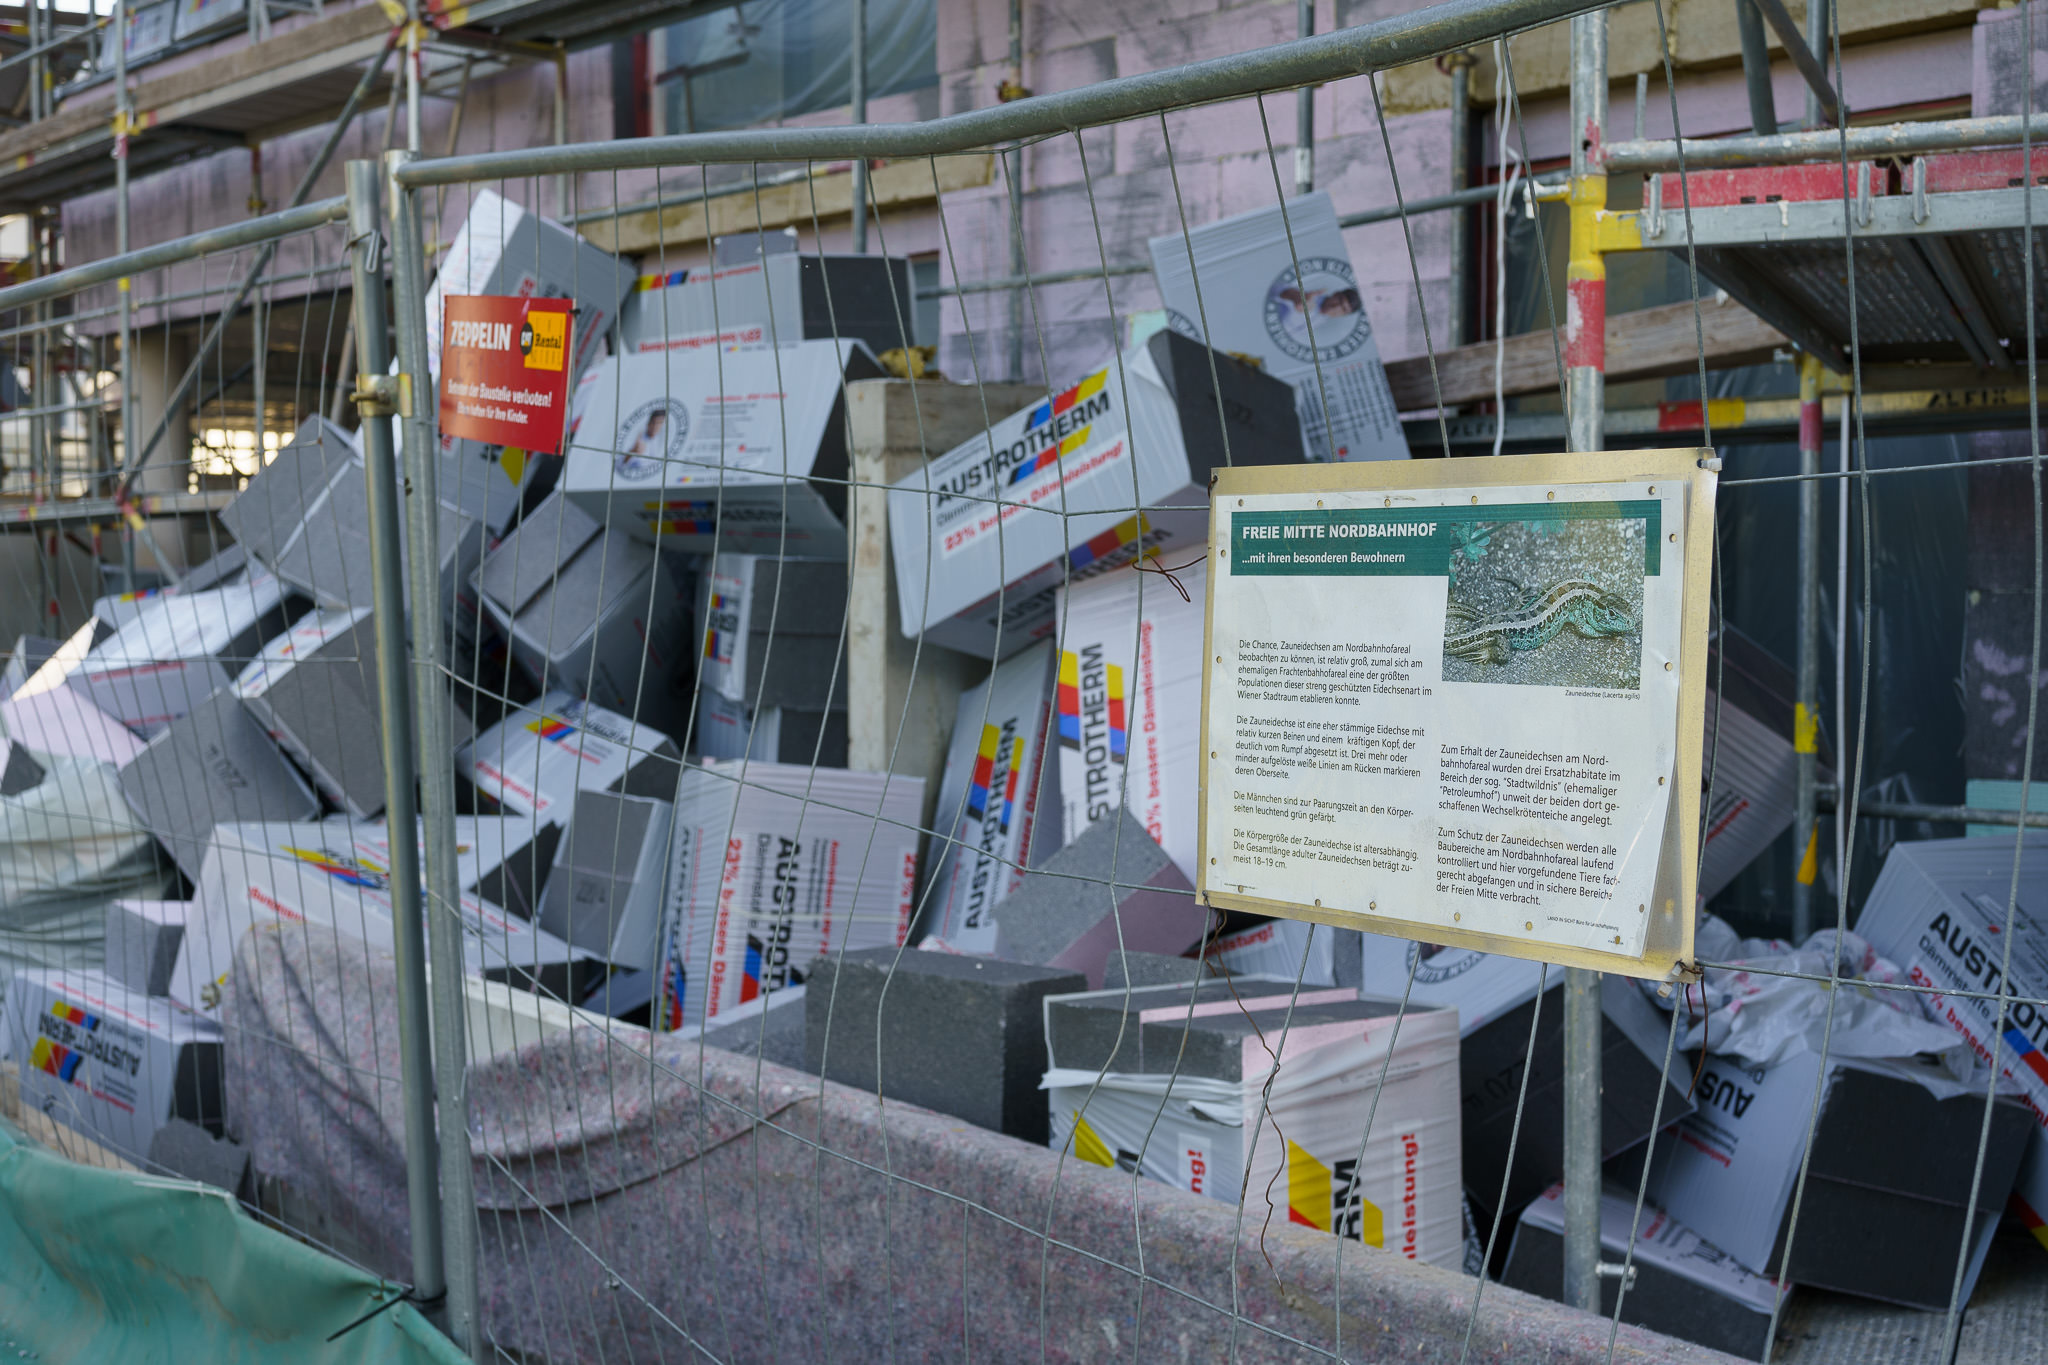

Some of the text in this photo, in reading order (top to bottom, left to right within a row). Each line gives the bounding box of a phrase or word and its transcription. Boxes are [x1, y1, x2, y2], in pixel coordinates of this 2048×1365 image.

[451, 320, 512, 351] ZEPPELIN
[535, 333, 562, 350] Rental
[480, 383, 511, 403] Baustelle
[512, 390, 552, 408] verboten!
[935, 391, 1112, 508] AUSTROTHERM
[1243, 522, 1437, 539] FREIE MITTE NORDBAHNHOF
[1242, 551, 1406, 563] ...mit ihren besonderen Bewohnern
[1239, 639, 1411, 654] Die Chance, Zauneidechsen am Nordbahnhofareal
[1238, 652, 1423, 668] beobachten zu können, ist relativ groß, zumal sich am
[1238, 665, 1278, 678] ehemaligen
[1349, 669, 1365, 680] eine
[1366, 670, 1379, 680] der
[1380, 670, 1410, 683] größten
[1237, 677, 1432, 696] Populationen dieser streng geschützten Eidechsenart im
[1237, 690, 1361, 706] Wiener Stadtraum etablieren konnte.
[1236, 715, 1425, 737] Die Zauneidechse ist eine eher stämmige Eidechse mit
[1235, 740, 1408, 763] deutlich vom Rumpf abgesetzt ist. Drei mehr oder
[1236, 728, 1416, 751] relativ kurzen Beinen und einem kräftigen Kopf, der
[1440, 744, 1609, 766] Zum Erhalt der Zauneidechsen am Nord-
[1146, 735, 1160, 800] bessere
[1440, 758, 1621, 781] bahnhofareal wurden drei Ersatzhabitate im
[1440, 771, 1468, 783] Bereich
[1469, 774, 1483, 785] der
[1484, 777, 1501, 789] sog.
[1438, 799, 1613, 828] schaffenen Wechselkrötenteiche angelegt.
[1502, 793, 1531, 804] unweit
[1532, 794, 1548, 805] der
[1549, 795, 1580, 808] beiden
[1582, 798, 1602, 810] dort
[1604, 802, 1620, 813] ge-
[964, 716, 1019, 931] AUSTROTHERM
[1438, 826, 1617, 856] Zum Schutz der Zauneidechsen werden alle
[723, 838, 743, 884] 23%
[1438, 840, 1614, 871] Baubereiche am Nordbahnhofareal laufend
[1437, 854, 1480, 869] kontrolliert
[1481, 861, 1498, 871] und
[1499, 862, 1516, 873] hier
[1517, 866, 1577, 881] vorgefundene
[1579, 871, 1601, 884] Tiere
[1436, 870, 1466, 881] gerecht
[1467, 872, 1516, 889] abgefangen
[1517, 880, 1535, 890] und
[1536, 880, 1545, 891] in
[1546, 882, 1577, 896] sichere
[1436, 882, 1541, 906] der Freien Mitte verbracht.
[763, 835, 801, 996] AUSTROT
[1917, 934, 1992, 1021] Dämmstoffe
[1929, 911, 2048, 1060] AUSTROT
[1333, 1158, 1362, 1242] RM
